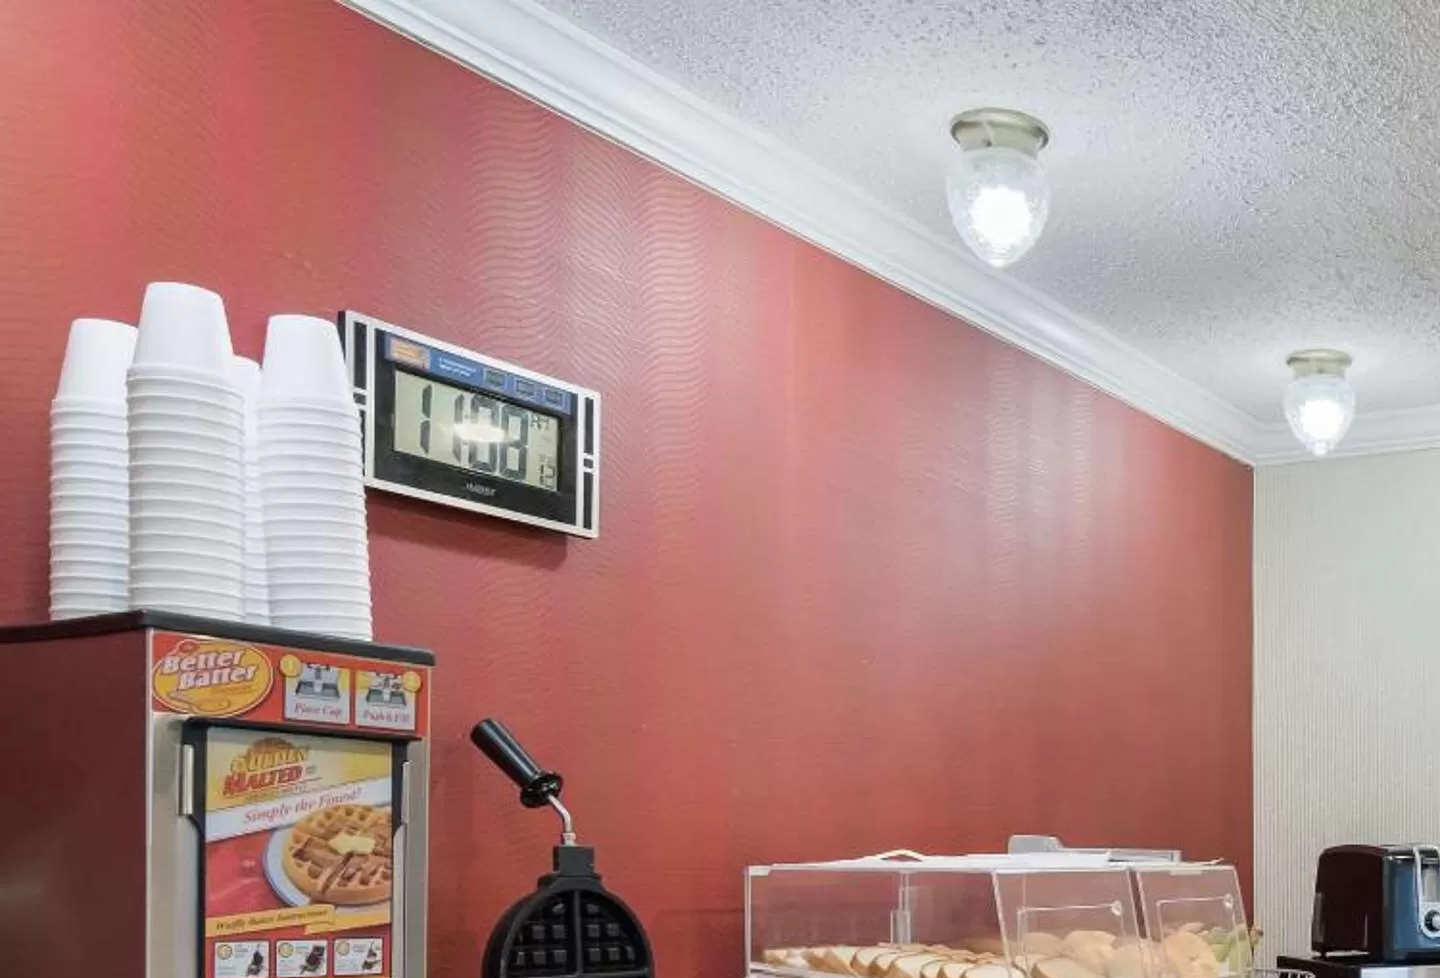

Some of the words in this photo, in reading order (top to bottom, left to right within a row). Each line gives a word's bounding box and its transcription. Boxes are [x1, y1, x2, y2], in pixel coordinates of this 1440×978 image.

[162, 649, 245, 674] Better
[178, 664, 257, 691] Batter
[223, 764, 304, 797] MALTED
[244, 802, 293, 824] Simply
[295, 797, 316, 813] the
